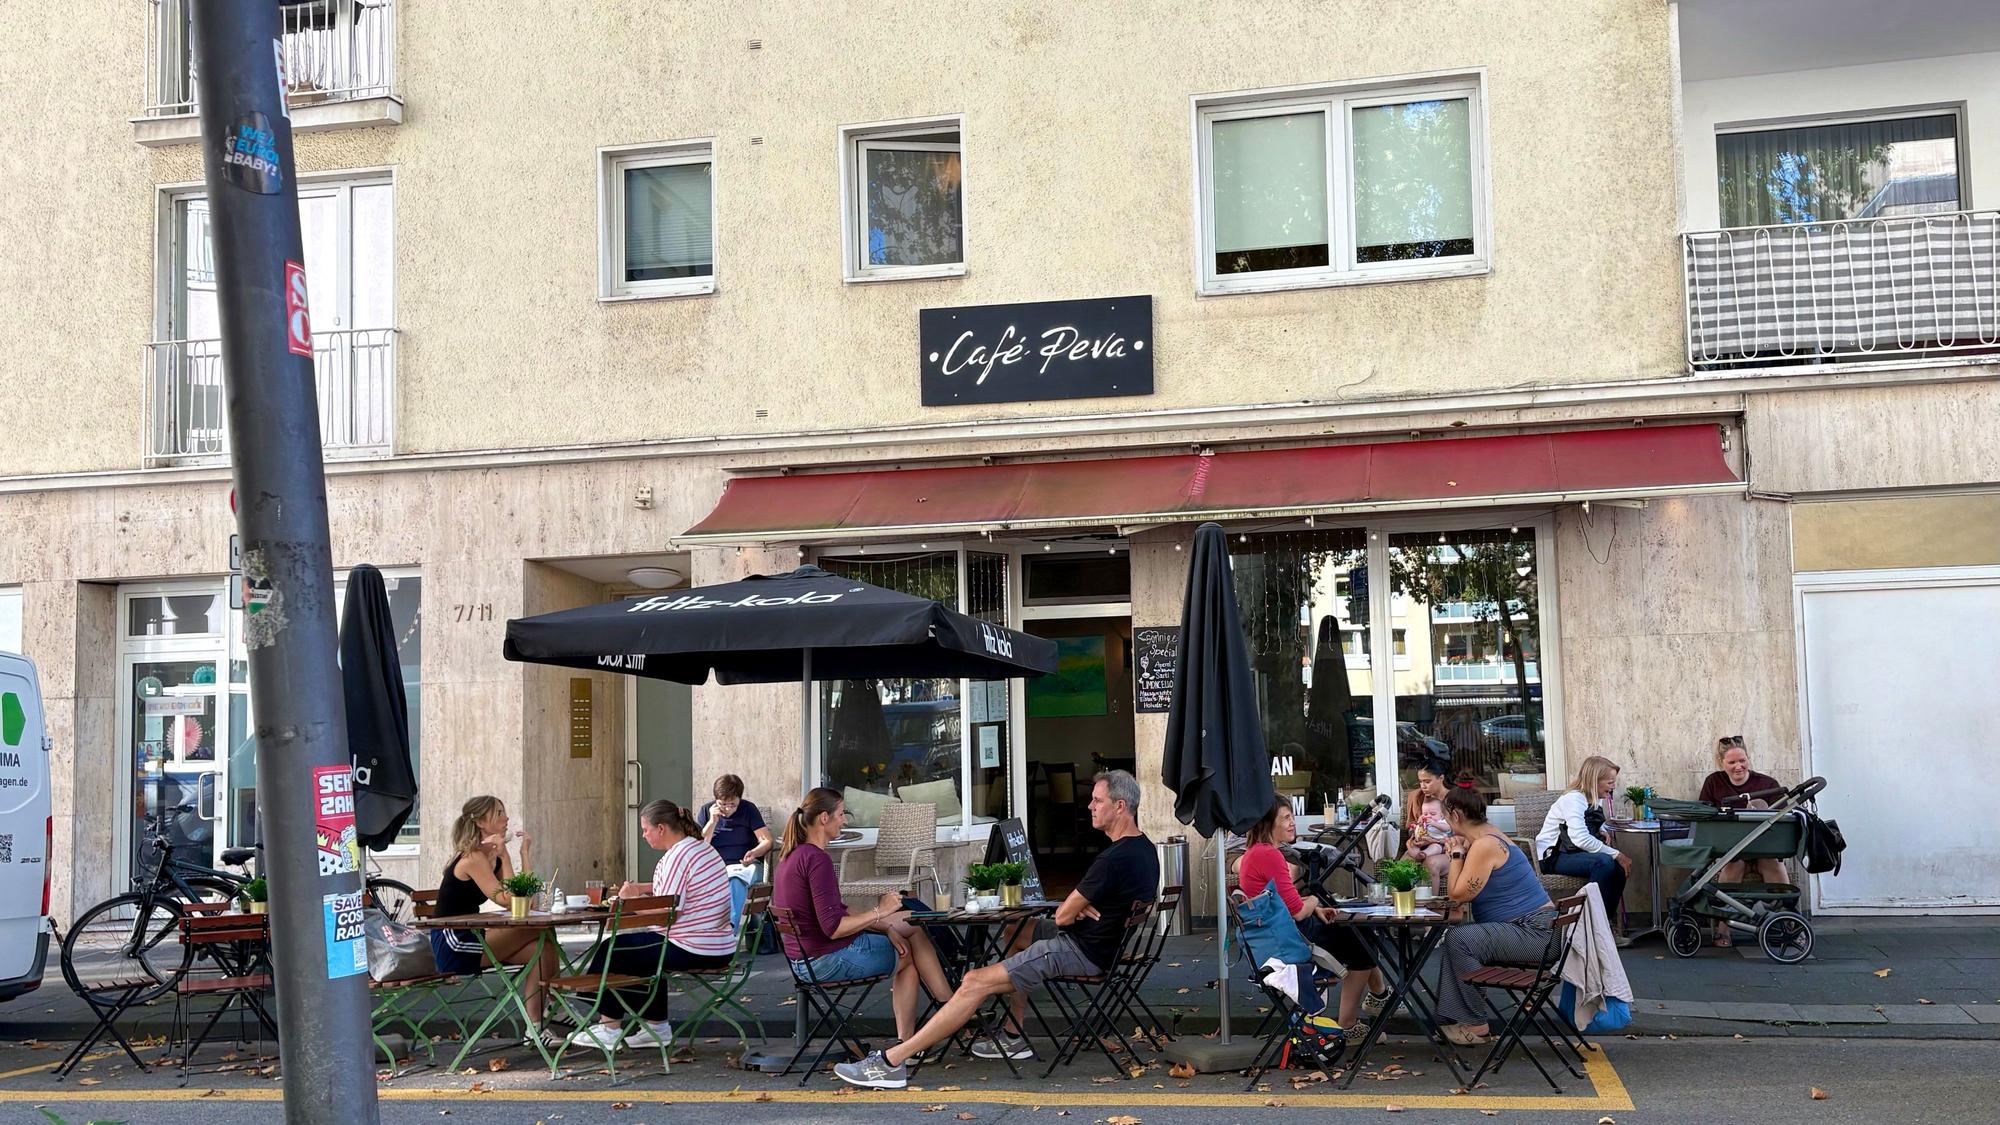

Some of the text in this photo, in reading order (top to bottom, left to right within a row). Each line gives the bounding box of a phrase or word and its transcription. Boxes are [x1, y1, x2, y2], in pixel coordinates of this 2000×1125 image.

[233, 151, 278, 176] BABY!
[942, 325, 1127, 385] Café Peva
[626, 591, 844, 613] fritz-kola
[350, 753, 371, 785] la
[1271, 756, 1294, 776] AN
[334, 895, 363, 911] SAVE
[337, 909, 364, 926] COS
